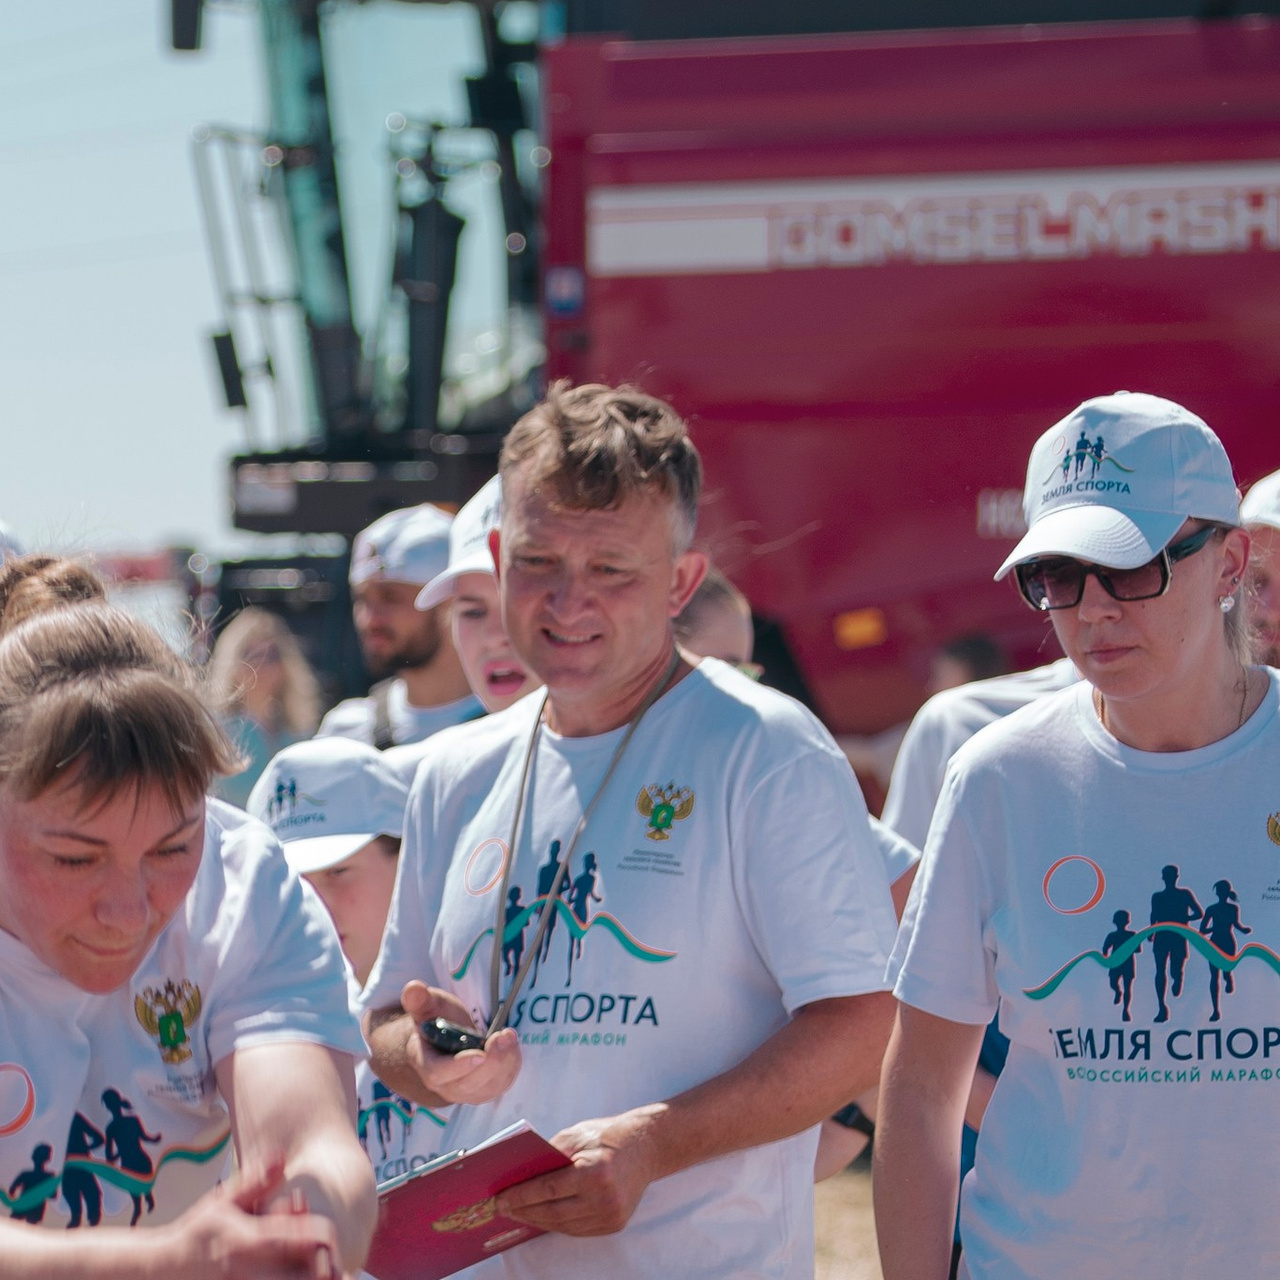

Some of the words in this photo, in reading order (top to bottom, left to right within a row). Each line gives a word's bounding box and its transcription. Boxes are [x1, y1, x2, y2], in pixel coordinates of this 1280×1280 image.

[1075, 480, 1131, 495] СПОРТА
[529, 992, 659, 1026] СПОРТА
[1048, 1027, 1151, 1061] ЕМЛЯ
